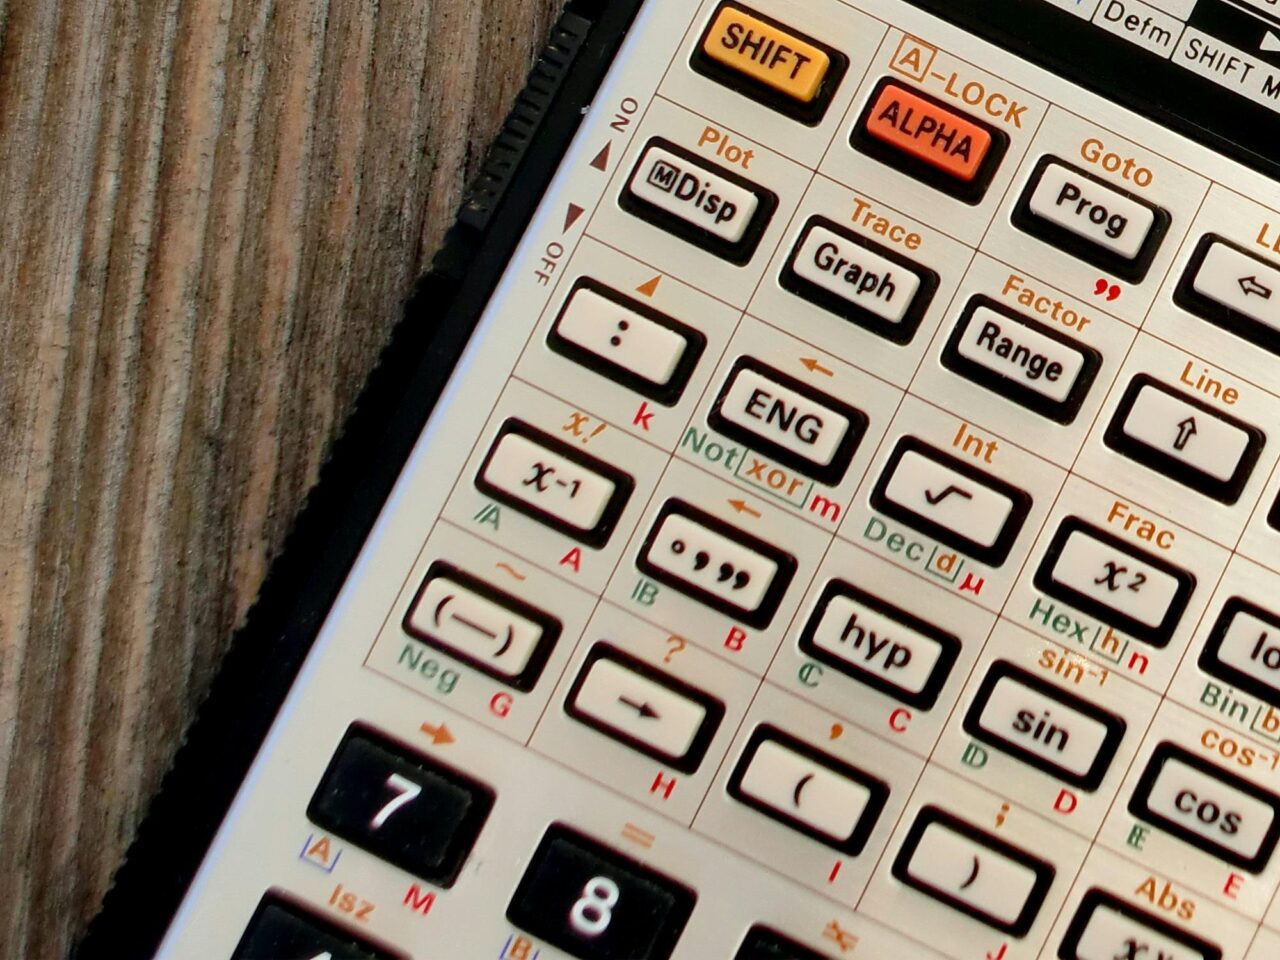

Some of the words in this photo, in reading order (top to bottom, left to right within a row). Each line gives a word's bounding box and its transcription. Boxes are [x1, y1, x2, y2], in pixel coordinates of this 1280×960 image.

[1103, 0, 1171, 46] Defm
[721, 23, 810, 79] SHIFT
[1184, 38, 1254, 83] SHIFT
[609, 97, 638, 133] ON
[878, 100, 972, 162] ALPHA
[697, 125, 754, 169] Plot
[1080, 138, 1153, 187] Goto
[851, 197, 921, 250] Trace
[1056, 182, 1127, 239] Prog
[534, 241, 564, 286] OFF
[814, 242, 895, 301] Graph
[1002, 274, 1090, 331] Factor
[976, 321, 1063, 381] Range
[1180, 360, 1239, 405] Line
[745, 388, 823, 444] ENG
[952, 423, 997, 463] Int
[681, 426, 738, 470] Not
[745, 459, 803, 495] xor
[809, 494, 841, 522] m
[863, 516, 924, 561] Dec
[936, 553, 957, 573] d
[1107, 501, 1174, 549] Frac
[559, 547, 581, 572] A
[663, 631, 689, 663] ?
[724, 626, 746, 651] B
[840, 614, 912, 669] hyp
[1029, 598, 1088, 643] Hex
[1101, 625, 1127, 654] h
[1127, 651, 1149, 674] n
[398, 644, 460, 694] Neg
[489, 692, 513, 717] G
[1199, 682, 1249, 722] Bin
[888, 707, 911, 732] C
[1012, 709, 1069, 751] sin
[371, 773, 421, 827] 7
[650, 772, 676, 799] H
[1053, 788, 1078, 813] D
[1174, 790, 1241, 835] cos
[308, 835, 331, 862] A
[403, 884, 435, 914] M
[1135, 875, 1197, 921] Abs
[1222, 872, 1244, 899] E
[570, 876, 619, 935] 8
